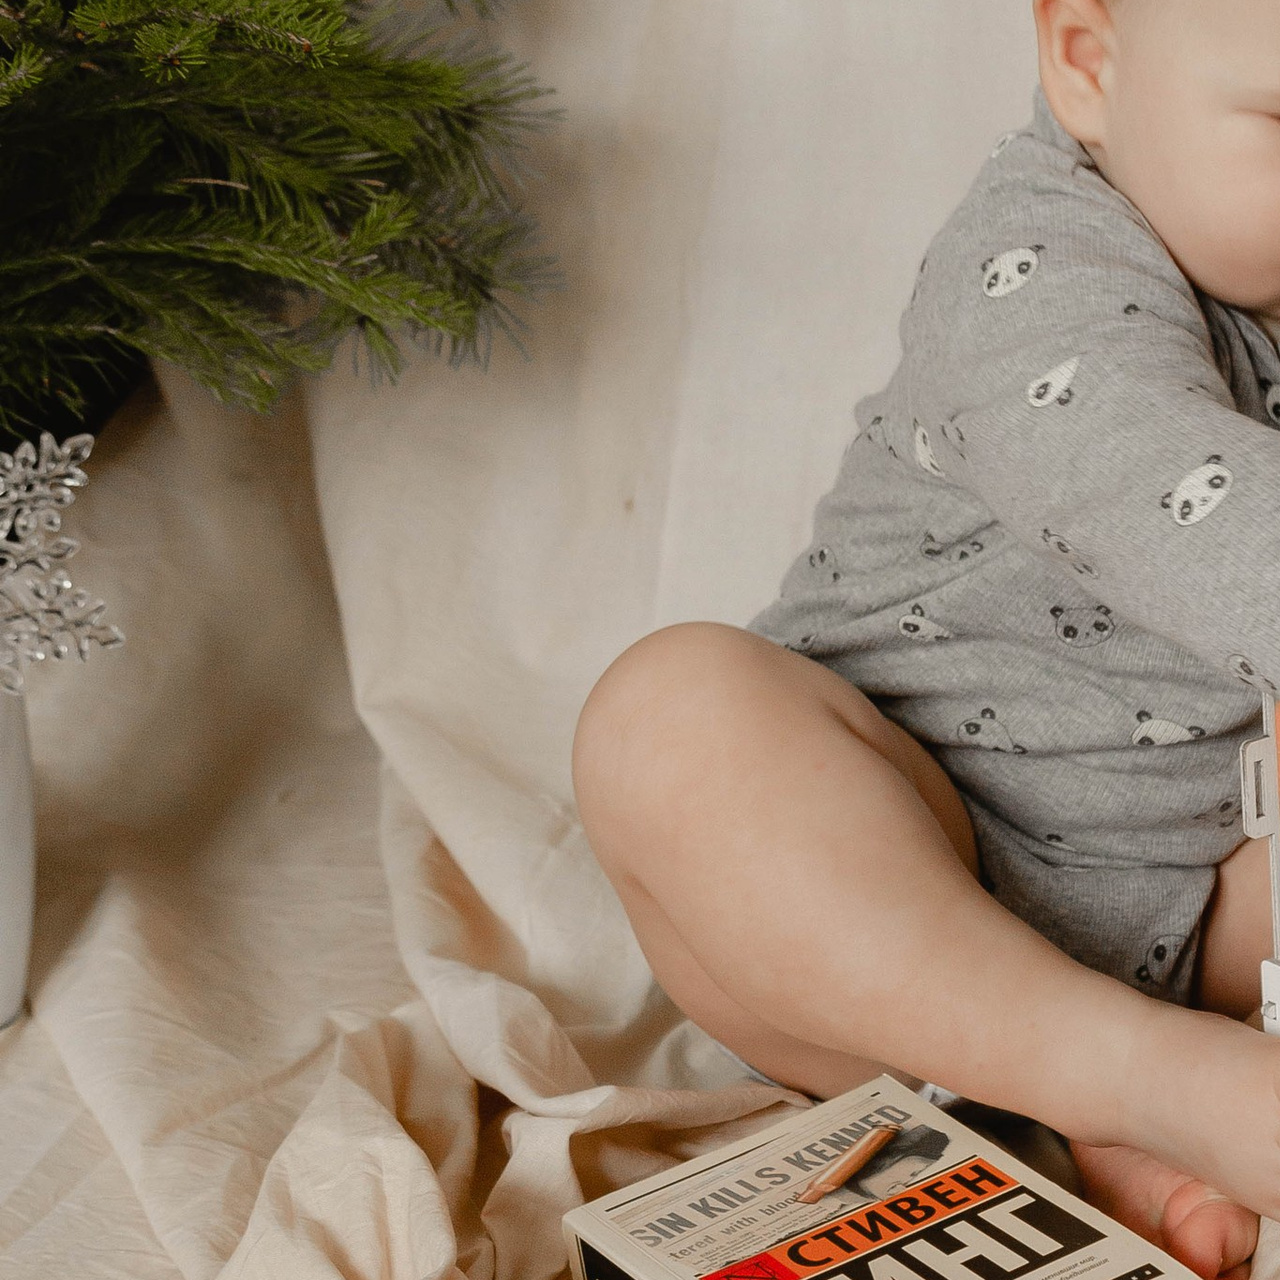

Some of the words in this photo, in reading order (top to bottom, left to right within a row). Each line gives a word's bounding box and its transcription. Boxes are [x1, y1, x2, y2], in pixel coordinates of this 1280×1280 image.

[687, 1163, 795, 1220] KILLS
[776, 1163, 1011, 1272] СТИВЕН
[716, 1212, 760, 1237] with
